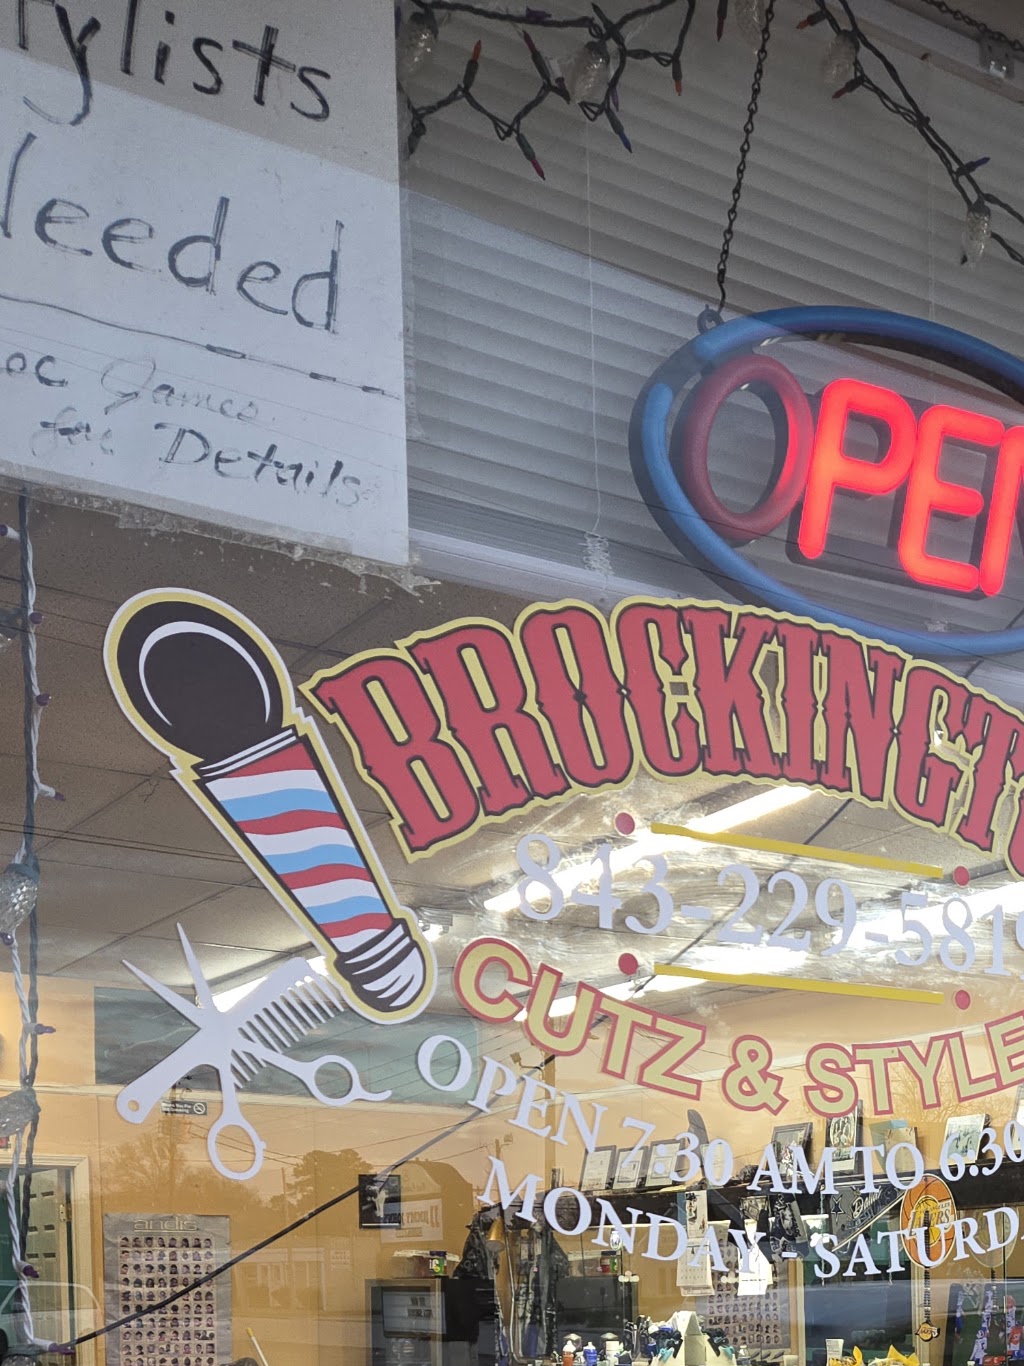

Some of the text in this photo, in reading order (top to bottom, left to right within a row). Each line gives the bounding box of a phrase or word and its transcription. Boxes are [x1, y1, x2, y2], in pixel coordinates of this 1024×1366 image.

[453, 937, 706, 1101] CUTZ
[721, 1034, 786, 1116] &
[417, 1034, 609, 1154] OPEN
[621, 1116, 734, 1187] 7:30
[746, 1143, 840, 1196] AM
[847, 1142, 925, 1194] TO
[133, 1217, 198, 1232] andis
[476, 1155, 768, 1275] MONDAY
